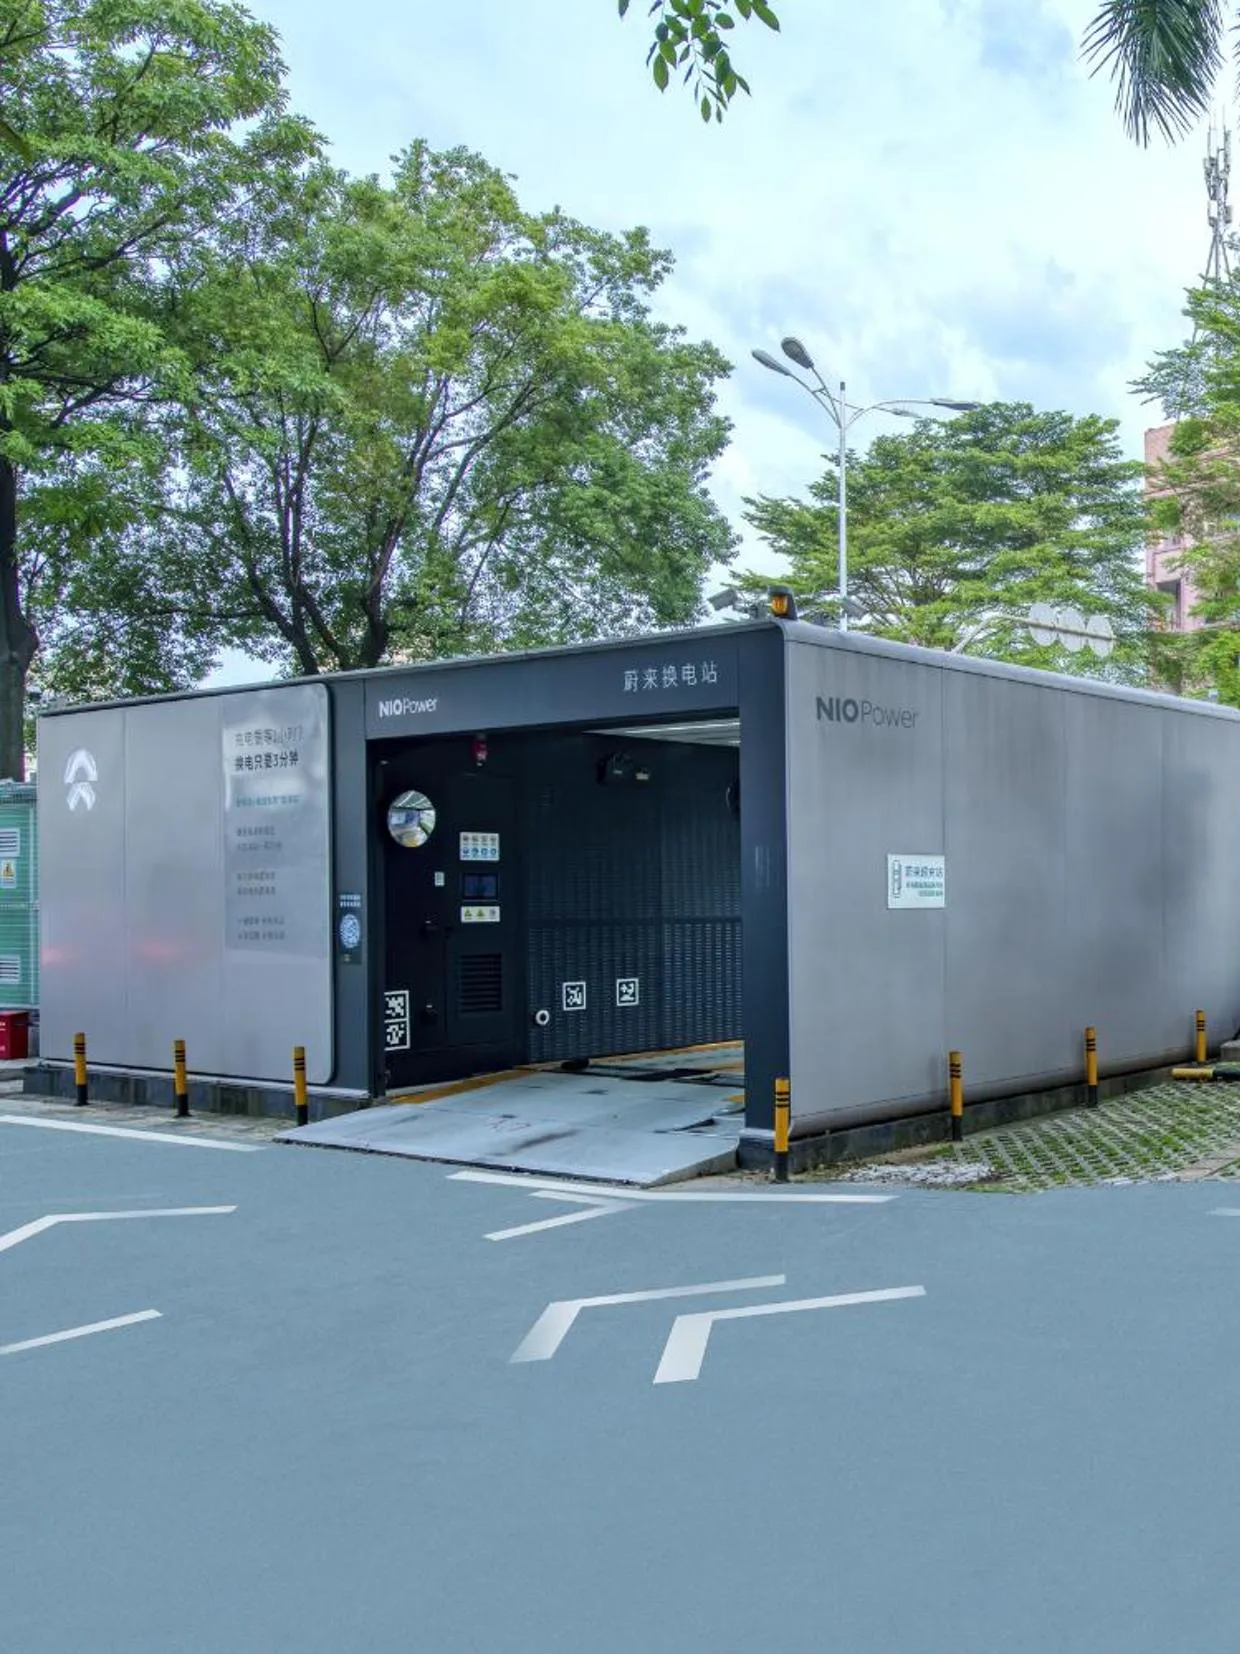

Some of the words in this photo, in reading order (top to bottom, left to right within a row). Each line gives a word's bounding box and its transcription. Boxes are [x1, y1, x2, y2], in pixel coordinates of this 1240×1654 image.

[623, 660, 717, 692] 蔚来换电站
